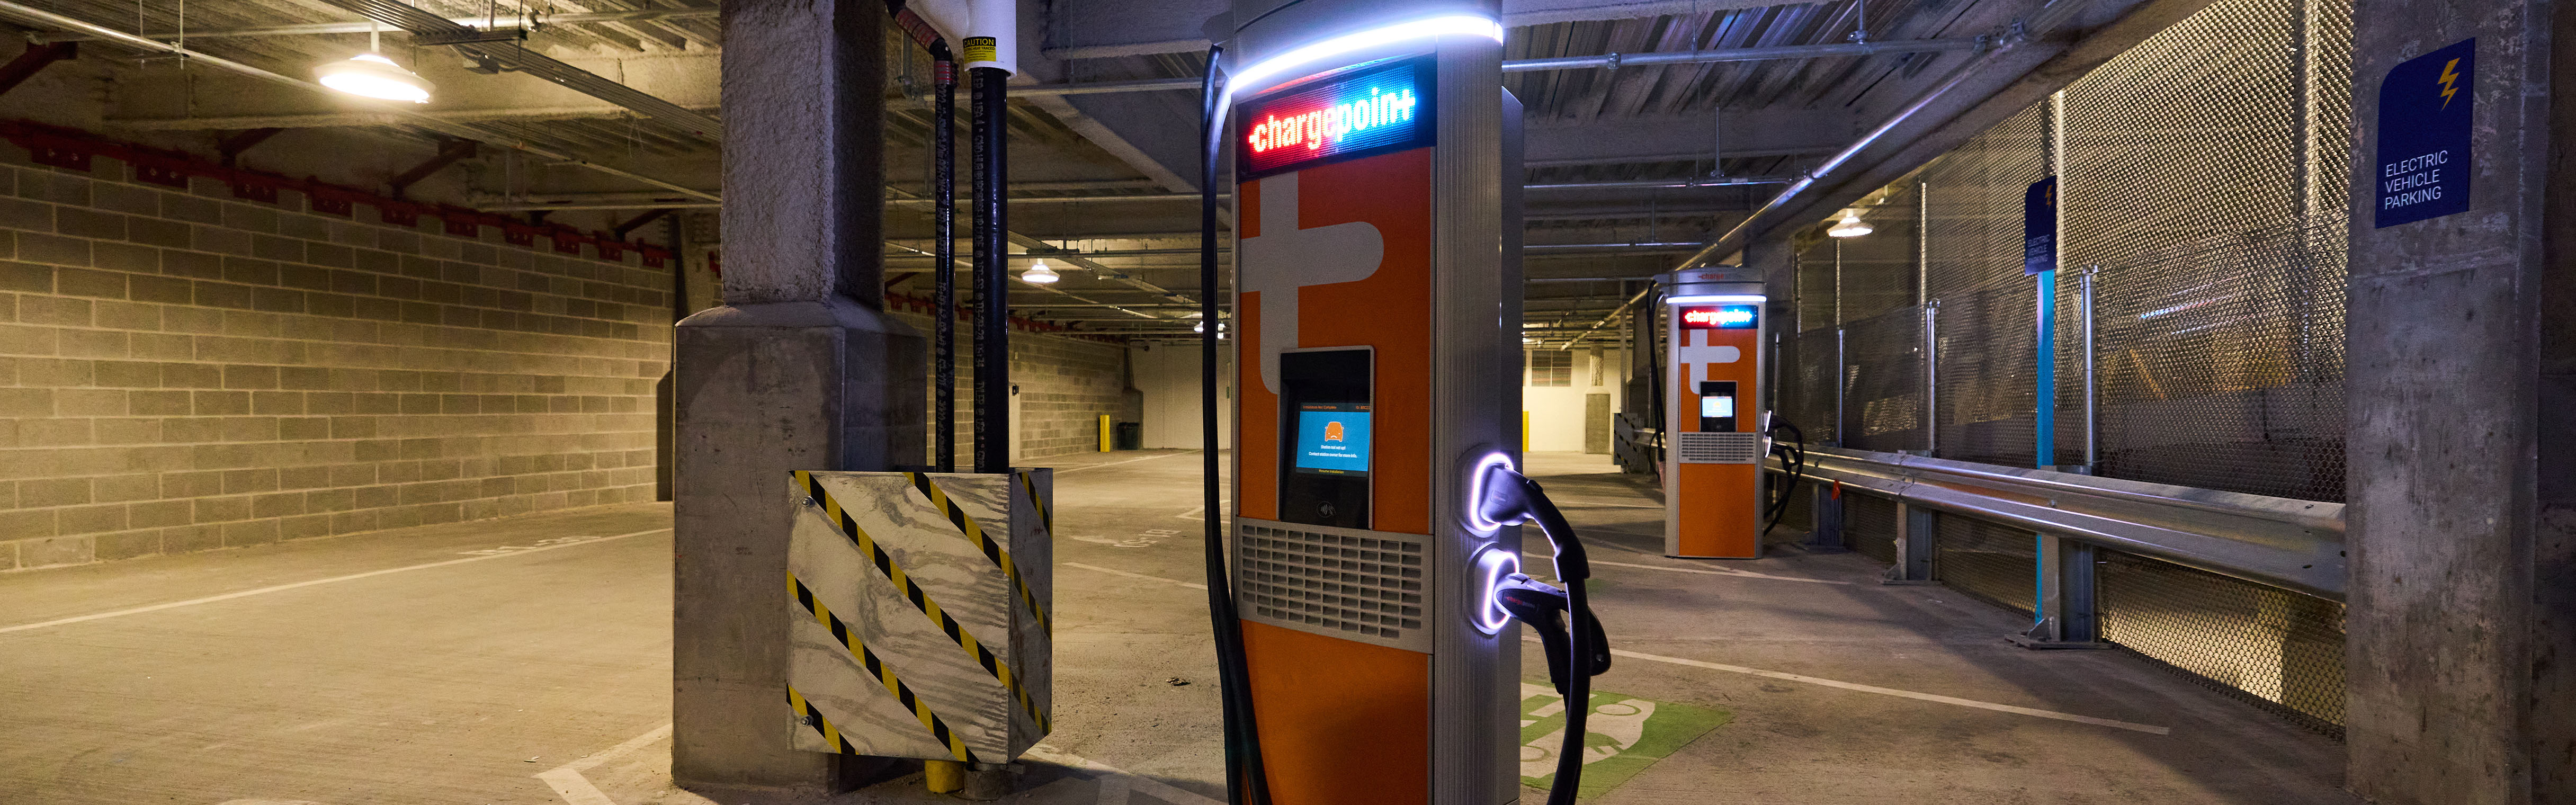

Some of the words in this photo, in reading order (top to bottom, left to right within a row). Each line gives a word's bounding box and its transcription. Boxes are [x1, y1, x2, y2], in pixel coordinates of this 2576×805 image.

[964, 38, 994, 47] CAUTION
[2386, 150, 2448, 177] ELECTRIC
[2385, 169, 2440, 193] VEHICLE
[2385, 186, 2441, 210] PARKING
[2027, 234, 2050, 248] ELECTRIC
[2028, 244, 2048, 256] VEHICLE
